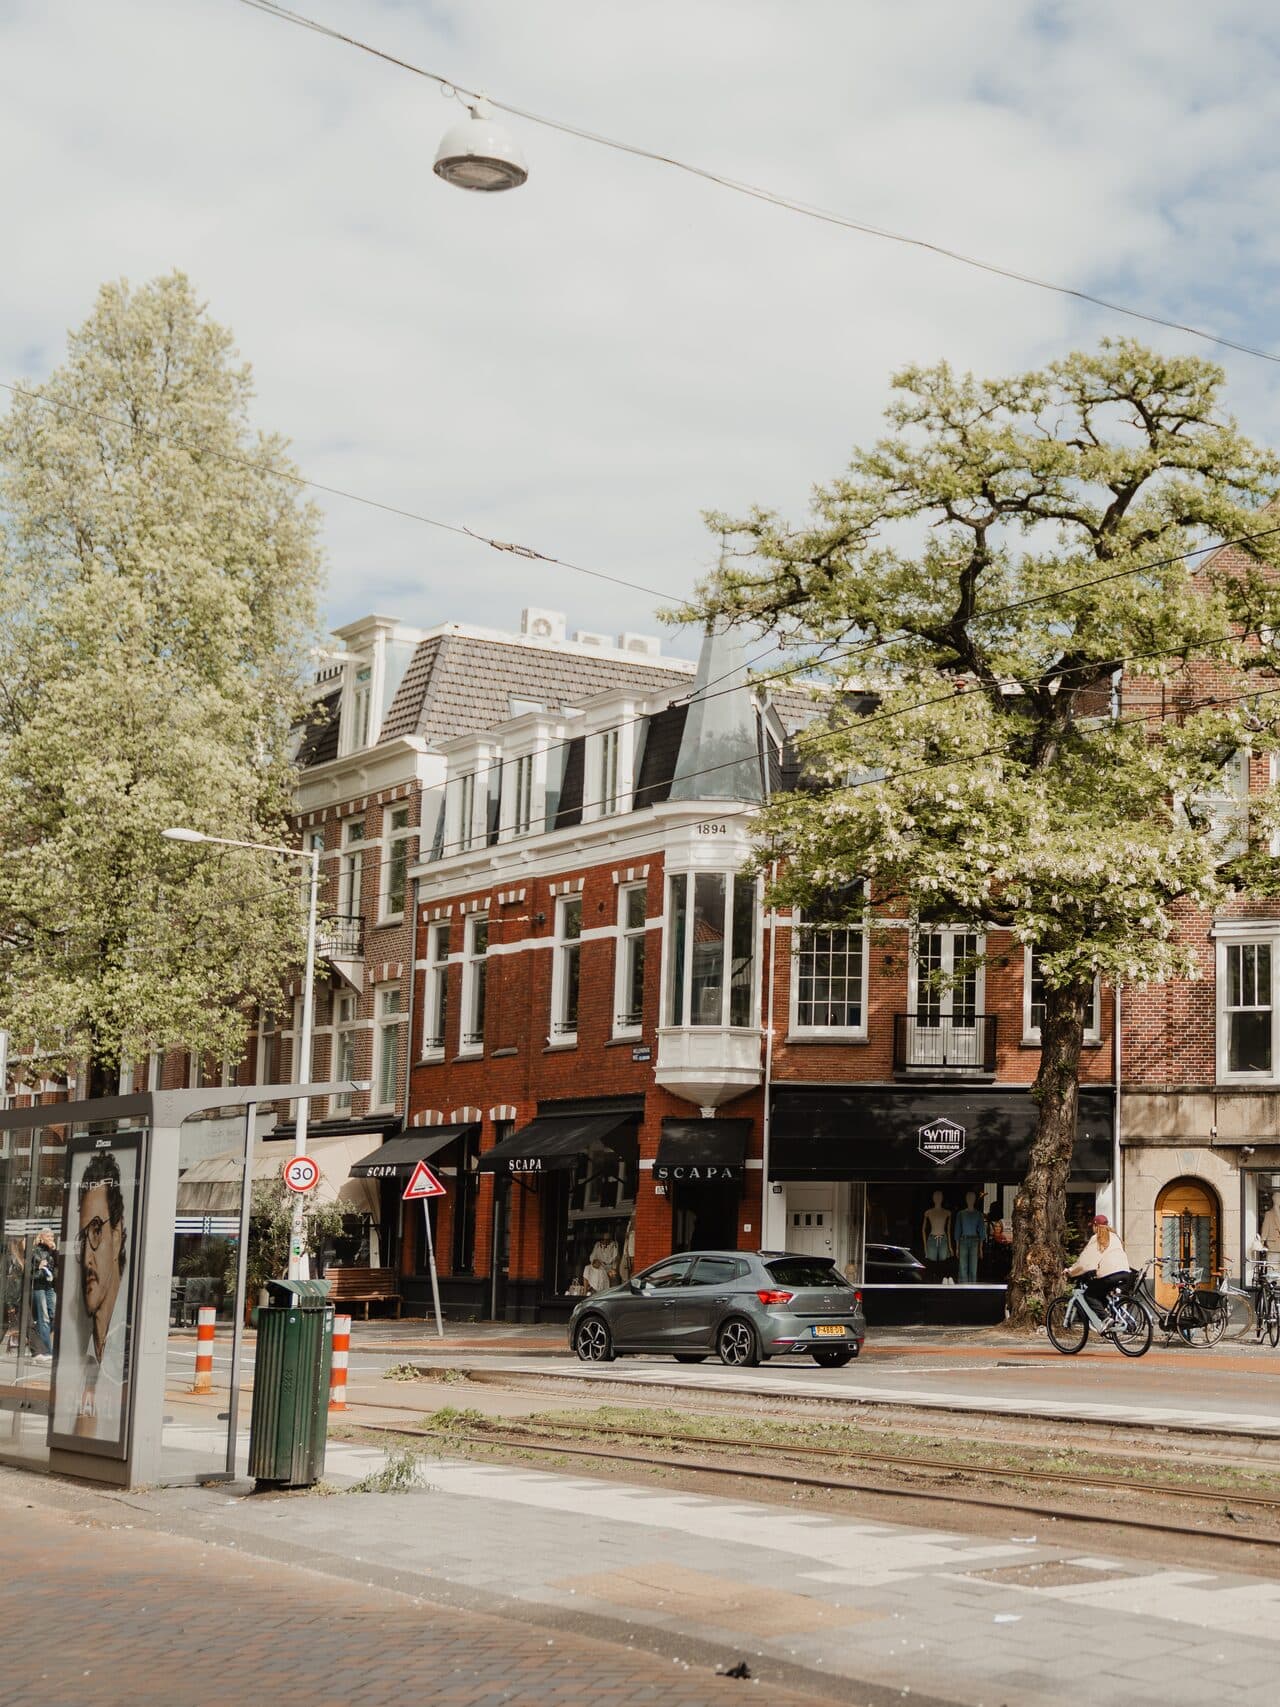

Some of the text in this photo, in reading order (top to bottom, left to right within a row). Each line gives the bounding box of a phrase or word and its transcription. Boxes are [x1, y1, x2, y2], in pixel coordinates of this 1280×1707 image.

[696, 824, 727, 834] 1894
[924, 1130, 960, 1142] WYNIA
[508, 1159, 542, 1170] SCAPA
[291, 1167, 313, 1181] 30
[366, 1166, 397, 1177] SCAPA
[658, 1167, 733, 1179] SCAPA
